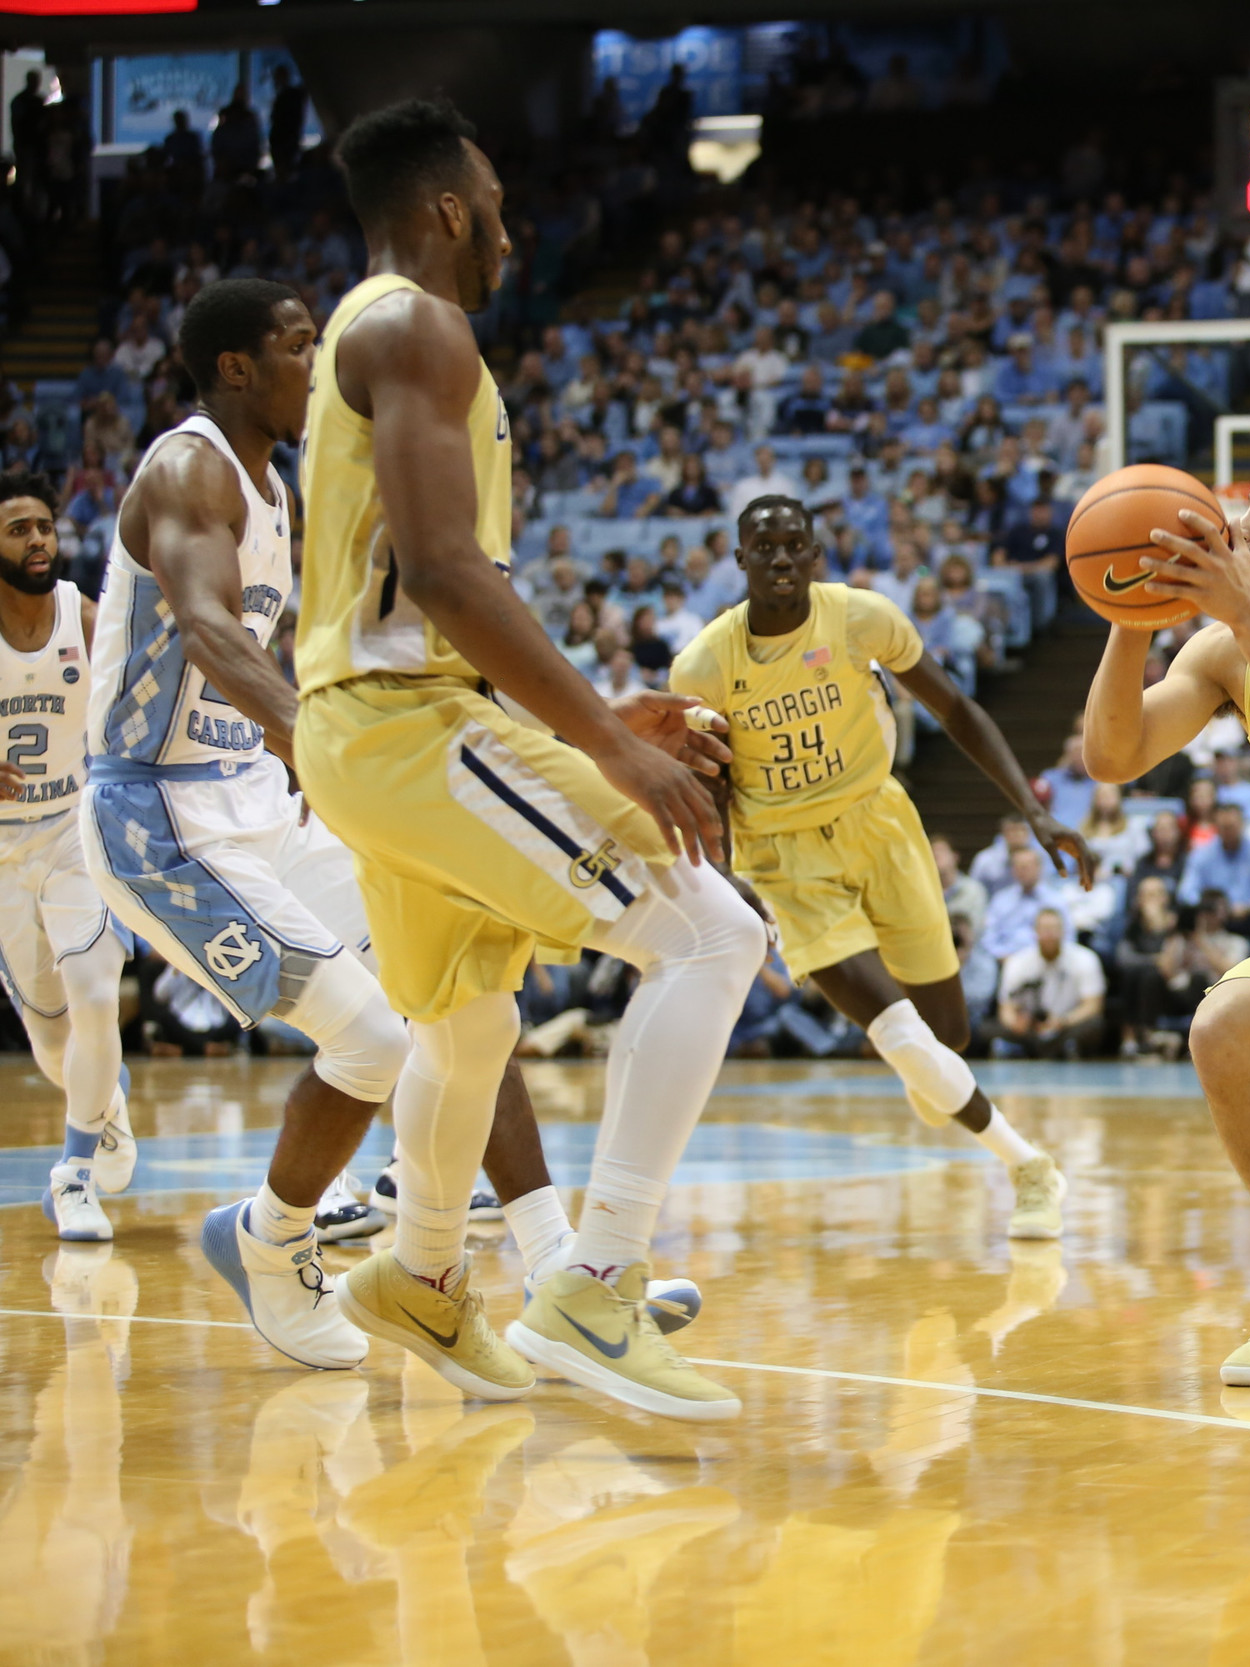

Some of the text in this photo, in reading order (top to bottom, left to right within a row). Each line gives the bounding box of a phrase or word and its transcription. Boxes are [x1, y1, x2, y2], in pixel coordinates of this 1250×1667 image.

[732, 683, 842, 731] GEORGIA
[7, 723, 48, 774] 2
[771, 724, 825, 764] 34
[5, 774, 79, 803] OLINA
[759, 749, 845, 791] TECH
